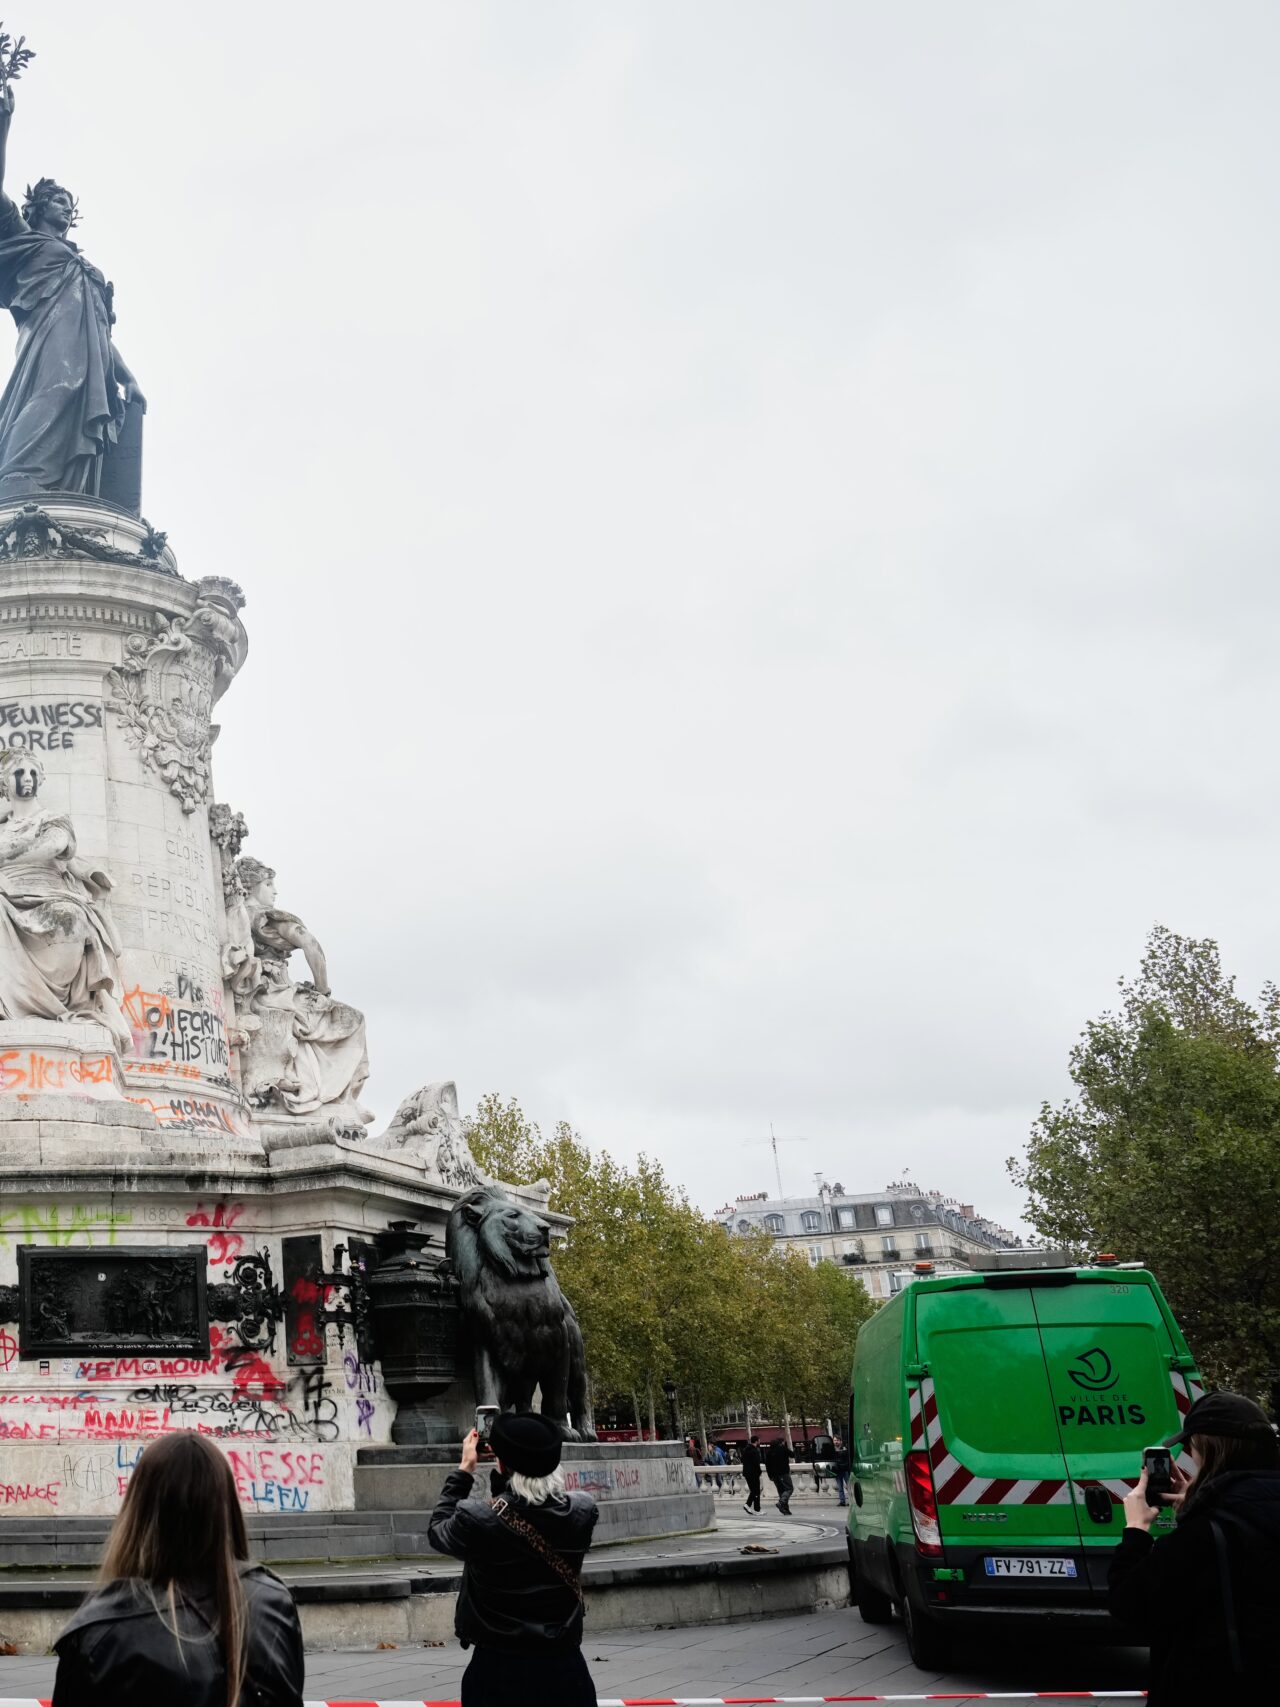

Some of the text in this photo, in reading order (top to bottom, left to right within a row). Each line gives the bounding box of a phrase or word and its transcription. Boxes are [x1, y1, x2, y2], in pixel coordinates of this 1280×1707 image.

[143, 1206, 180, 1221] 1880
[1070, 1393, 1129, 1402] VILLE DE
[1058, 1404, 1146, 1426] PARIS
[227, 1451, 324, 1485] NESSE
[995, 1559, 1067, 1575] FV-791-ZZ
